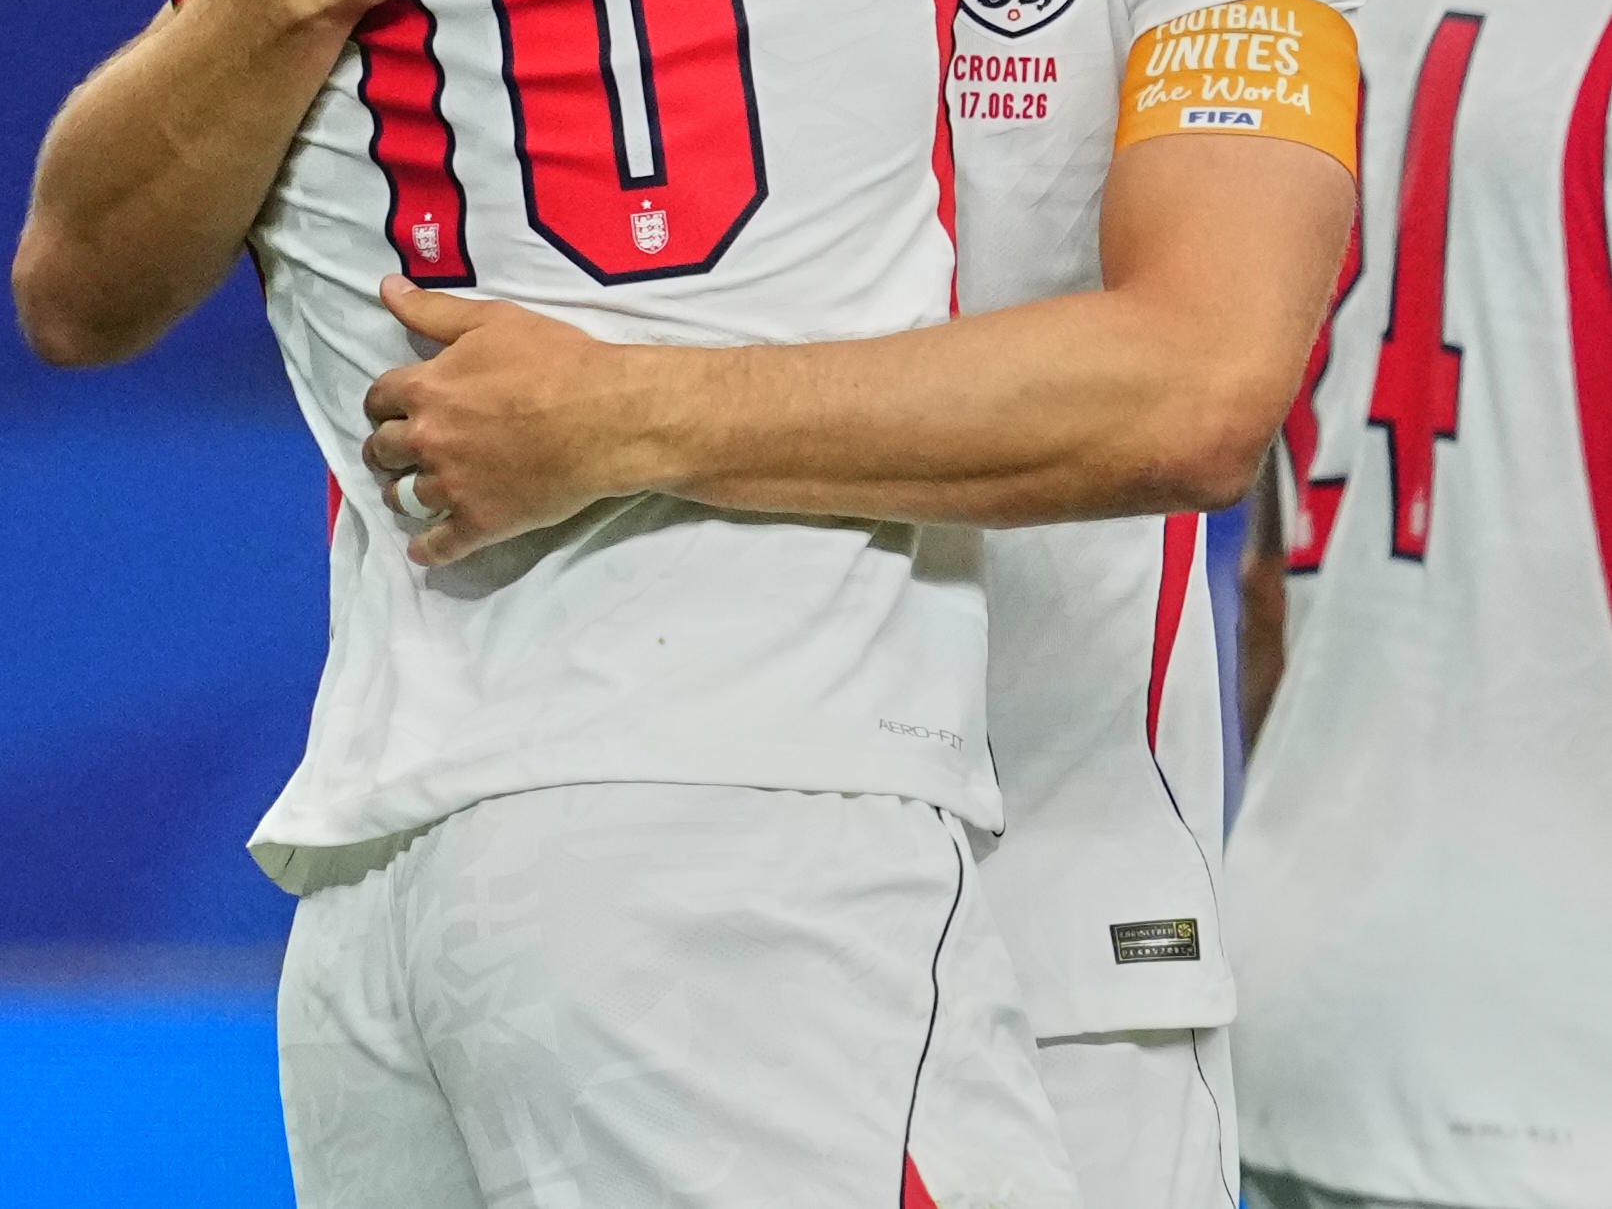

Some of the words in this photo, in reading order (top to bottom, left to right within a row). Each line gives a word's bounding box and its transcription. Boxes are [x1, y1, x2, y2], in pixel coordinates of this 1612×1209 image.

[953, 54, 1058, 83] CROATIA
[1145, 32, 1300, 77] UNITES
[960, 91, 1048, 120] 17.06.26
[1136, 78, 1193, 112] the
[1200, 74, 1312, 115] World
[1187, 110, 1255, 126] FIFA
[879, 718, 965, 751] AERO-FIT
